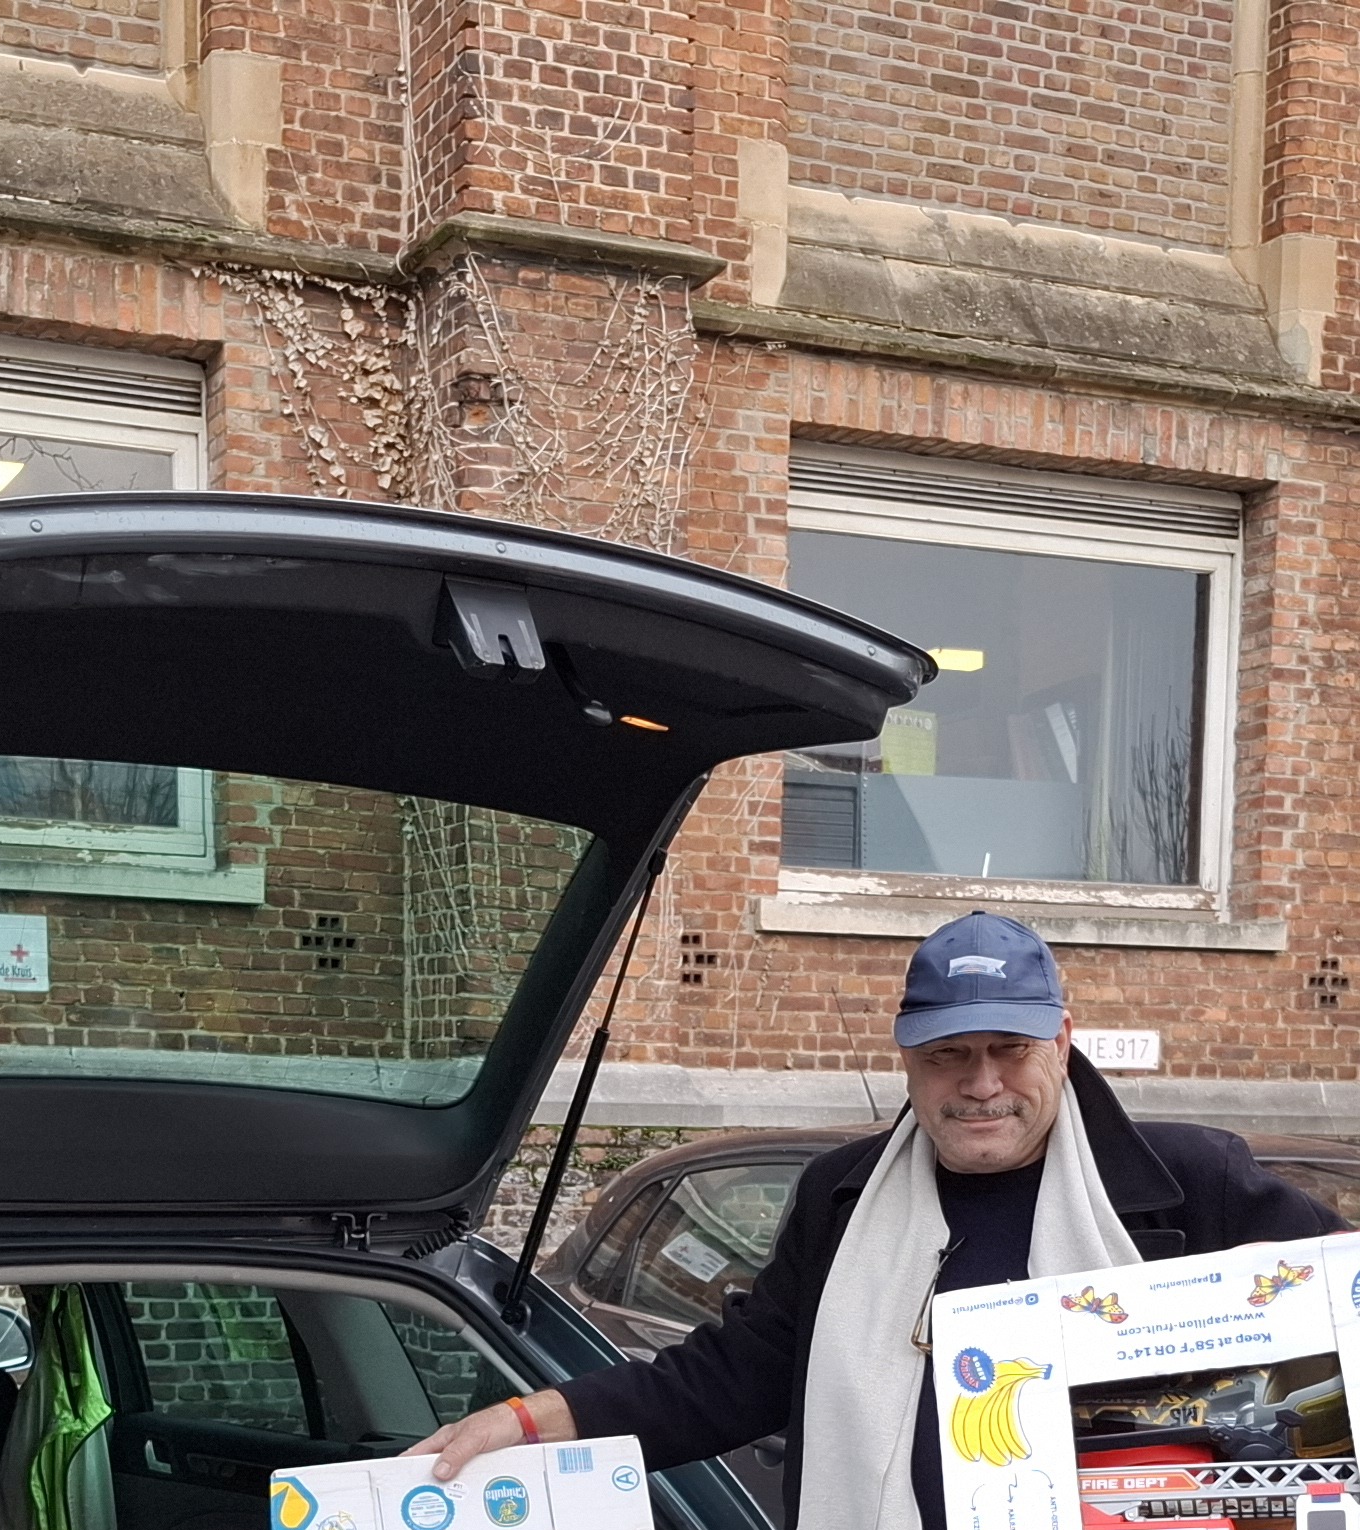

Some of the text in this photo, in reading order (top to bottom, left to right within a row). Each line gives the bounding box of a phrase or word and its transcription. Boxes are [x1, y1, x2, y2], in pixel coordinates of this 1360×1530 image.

[1116, 1311, 1265, 1336] www.papillon-fruit.com
[1217, 1337, 1232, 1347] at
[1234, 1332, 1272, 1345] Keep
[1154, 1343, 1176, 1356] OR
[1082, 1478, 1168, 1489] FIRE DEPT
